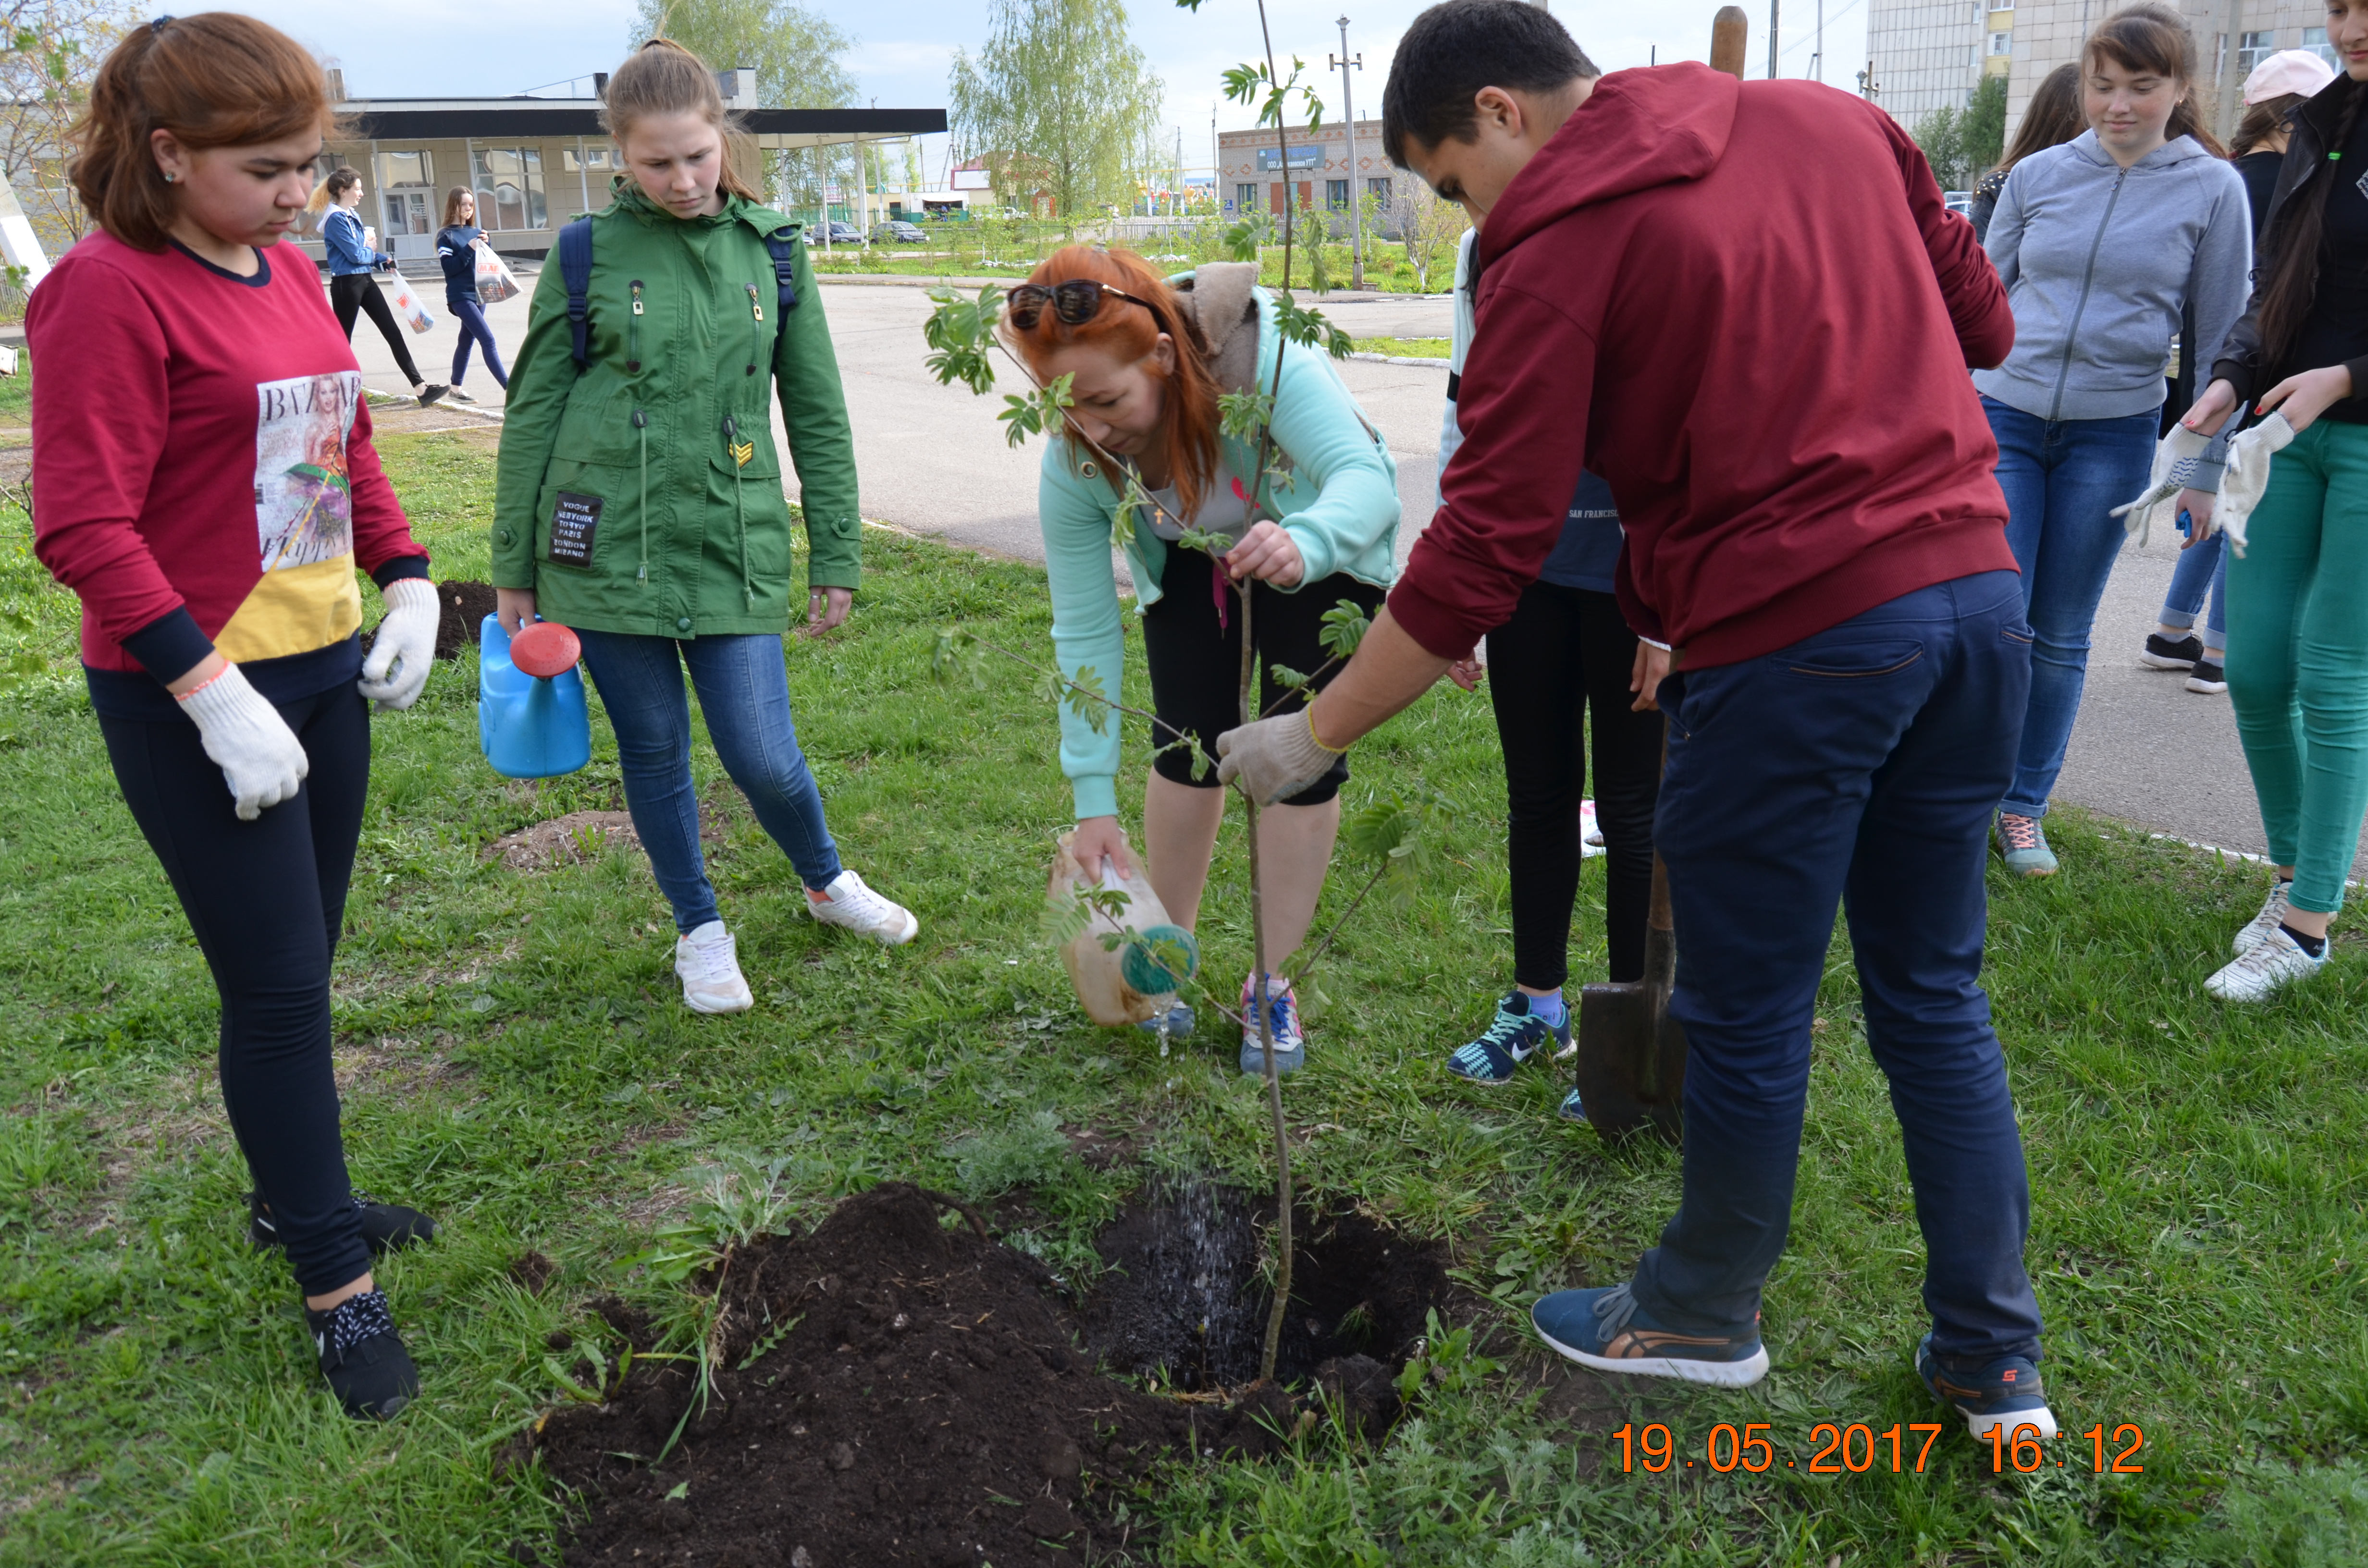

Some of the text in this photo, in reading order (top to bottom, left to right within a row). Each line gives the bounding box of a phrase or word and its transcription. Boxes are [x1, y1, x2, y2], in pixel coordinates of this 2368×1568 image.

[1267, 147, 1317, 160] ДИСТЧЕРСКАЯ
[563, 502, 590, 513] VOGUE
[1569, 510, 1582, 518] SAN
